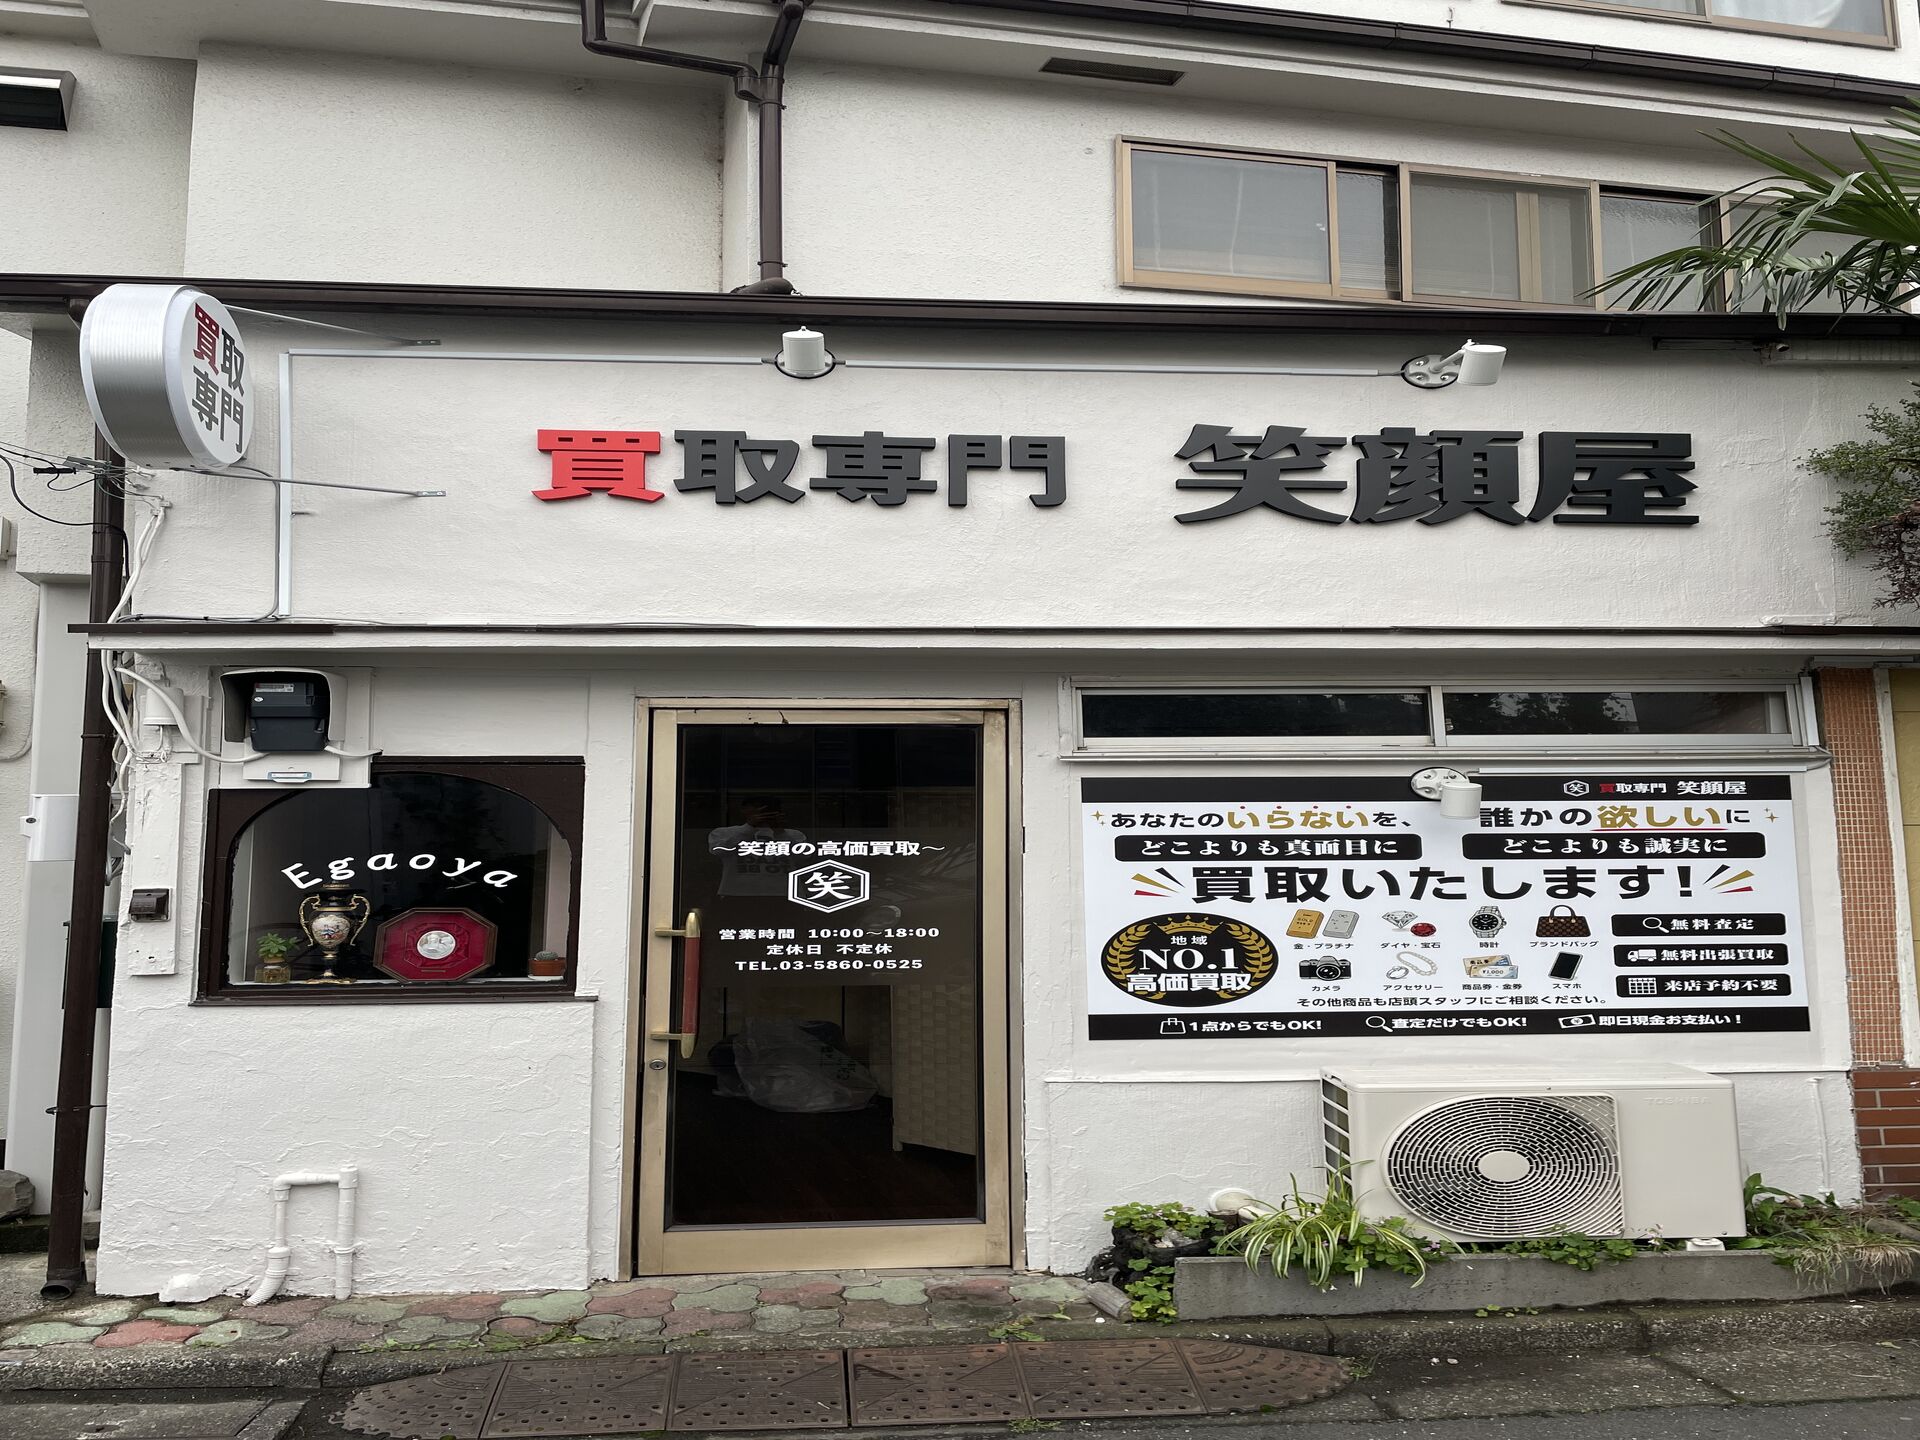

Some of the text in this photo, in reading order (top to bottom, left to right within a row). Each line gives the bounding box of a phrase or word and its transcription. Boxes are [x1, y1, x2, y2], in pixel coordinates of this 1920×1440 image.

[193, 302, 245, 397] 買取
[192, 365, 244, 454] 専門
[532, 422, 1701, 527] 買取専門 笑顔屋
[1600, 780, 1747, 795] 買取専門 笑顔屋
[1110, 805, 1750, 830] あなたのいらないを、 誰かの欲しいに
[1141, 838, 1399, 857] どこよりも真面目に
[1503, 837, 1728, 855] どこよりも誠実に
[281, 852, 518, 889] Egaoya
[804, 871, 855, 900] 笑
[1191, 864, 1693, 904] 買取いたします!
[1670, 918, 1755, 931] 無料査定
[719, 928, 796, 940] 営業時間
[1170, 935, 1209, 946] 地域
[766, 943, 893, 956] 定休日 不定休
[1479, 941, 1500, 949] 時計
[1530, 940, 1599, 948] ブランドバッグ
[1139, 948, 1240, 971] NO.1
[1661, 948, 1775, 961] 無料出張買取
[735, 959, 923, 971] TEL.03-5860-0525
[1126, 973, 1252, 993] 高価買取
[1664, 978, 1778, 992] 来店予約不要
[1297, 993, 1607, 1007] その他商品も店頭スタッフにご相談ください。
[1189, 1019, 1322, 1032] 1点からでもOK!
[1392, 1016, 1528, 1030] 査定だけでもOK!
